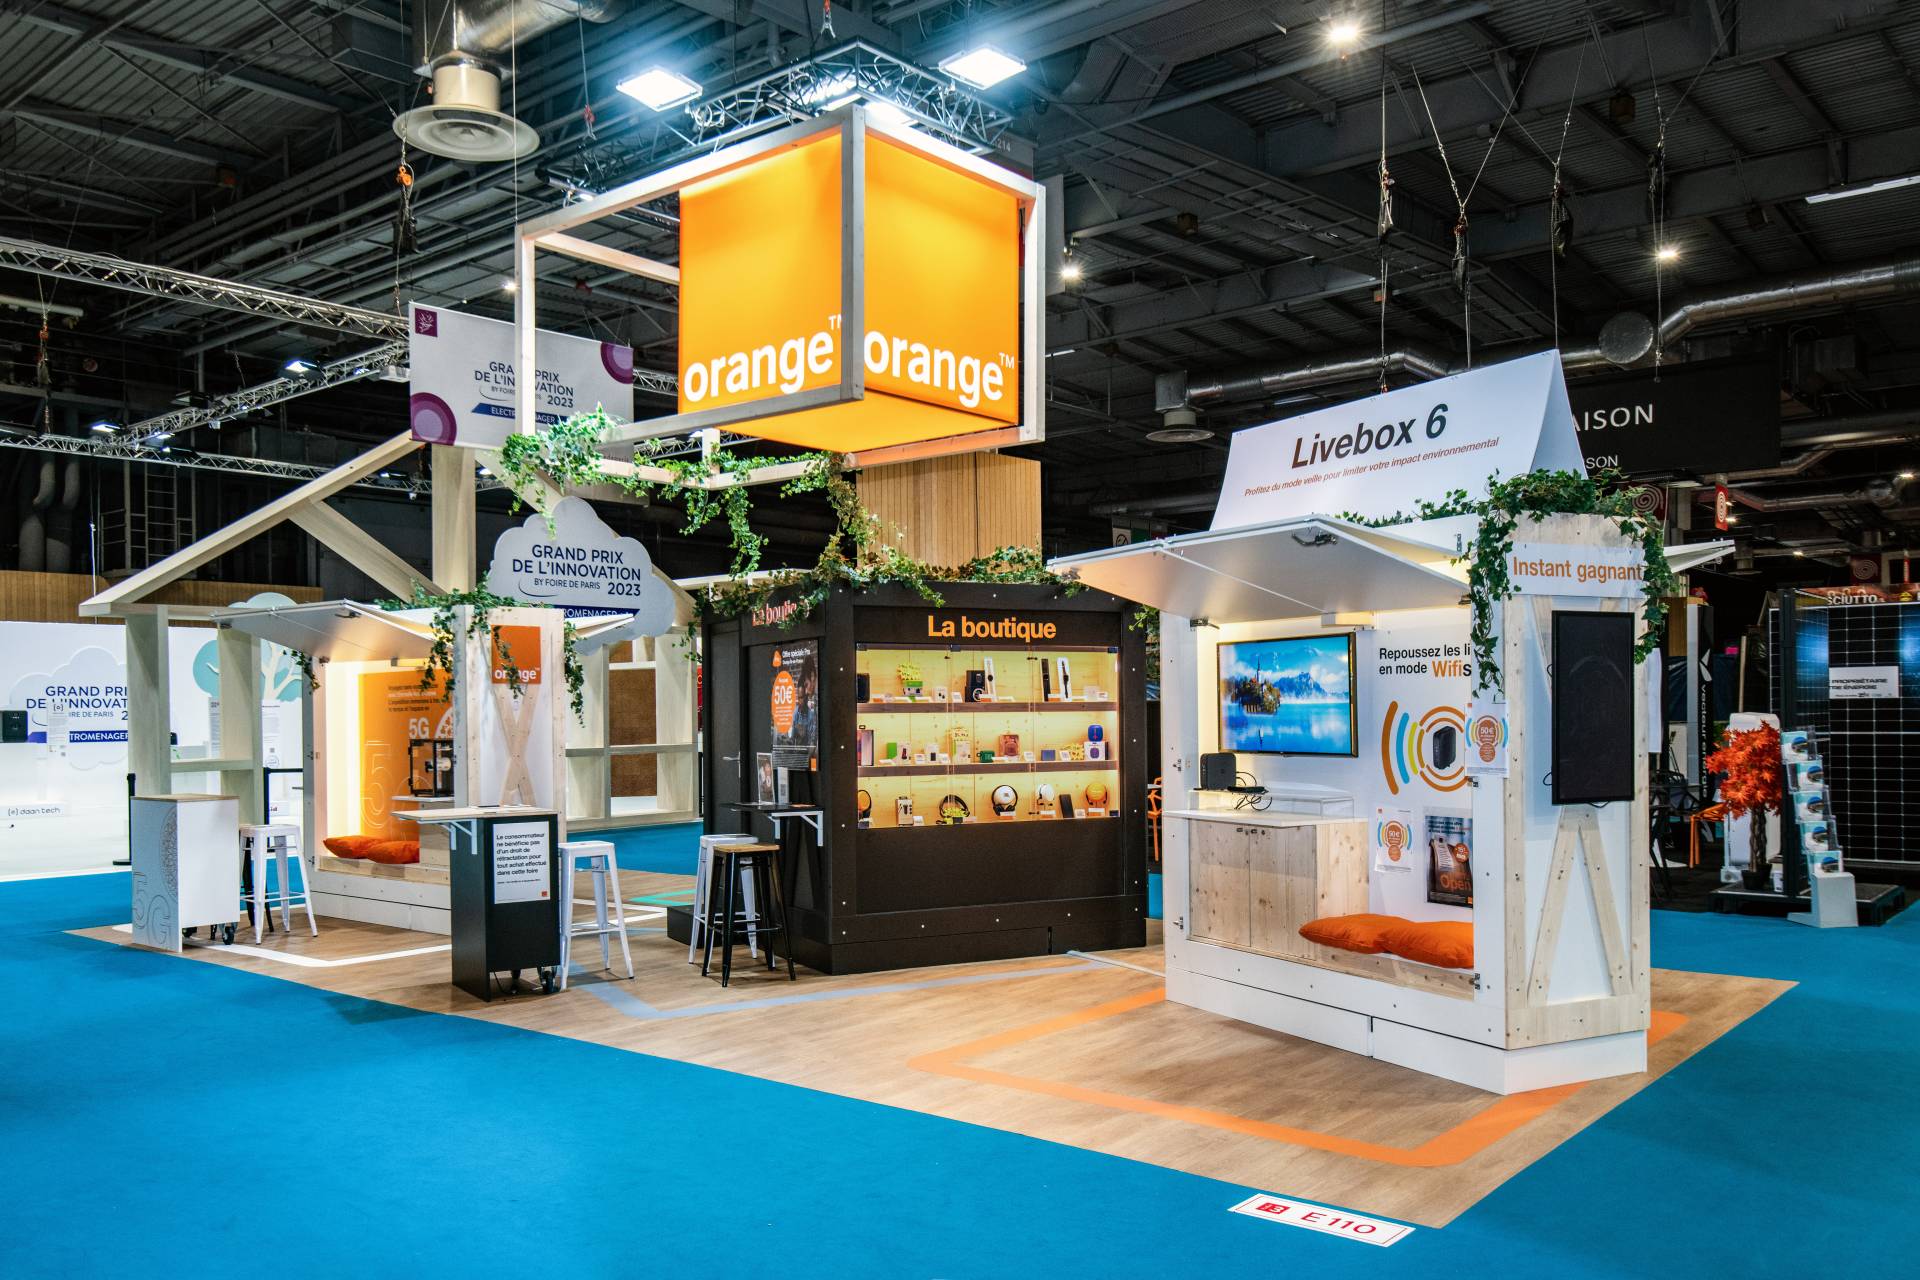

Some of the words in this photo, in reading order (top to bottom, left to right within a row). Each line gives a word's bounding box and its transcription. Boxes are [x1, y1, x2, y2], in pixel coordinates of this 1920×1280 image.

[474, 370, 491, 382] DE
[489, 361, 515, 375] GRA
[684, 331, 834, 402] orange
[864, 330, 1003, 408] orange
[547, 395, 574, 408] 2023
[1573, 403, 1653, 432] ISON
[1291, 418, 1416, 469] Livebox
[1425, 403, 1448, 439] 6
[1244, 484, 1271, 496] Profitez
[1271, 482, 1281, 491] du
[1281, 478, 1302, 489] mode
[1303, 474, 1323, 484] veille
[1323, 471, 1342, 483] pour
[1342, 465, 1368, 477] limiter
[1369, 461, 1390, 472] votre
[1391, 454, 1421, 467] impact
[1422, 436, 1500, 461] environnemental
[1585, 455, 1618, 469] SON
[532, 544, 587, 561] GRAND
[591, 549, 624, 564] PRIX
[512, 559, 534, 573] DE
[538, 561, 641, 581] L'INNOVATION
[1513, 556, 1572, 578] Instant
[1576, 563, 1643, 584] gagnant
[534, 578, 544, 586] BY
[545, 578, 568, 588] FOIRE
[568, 580, 579, 588] DE
[580, 581, 601, 590] PARIS
[607, 582, 641, 597] 2023
[928, 615, 955, 637] La
[961, 615, 1057, 643] boutique
[1379, 647, 1441, 661] Repoussez
[1443, 644, 1460, 656] les
[1379, 665, 1392, 675] en
[1395, 661, 1428, 674] mode
[45, 686, 100, 697] GRAND
[105, 686, 128, 697] PRI
[26, 698, 47, 709] DE
[409, 717, 430, 740] 5G
[1300, 1211, 1327, 1223] E
[1327, 1217, 1377, 1234] 110
